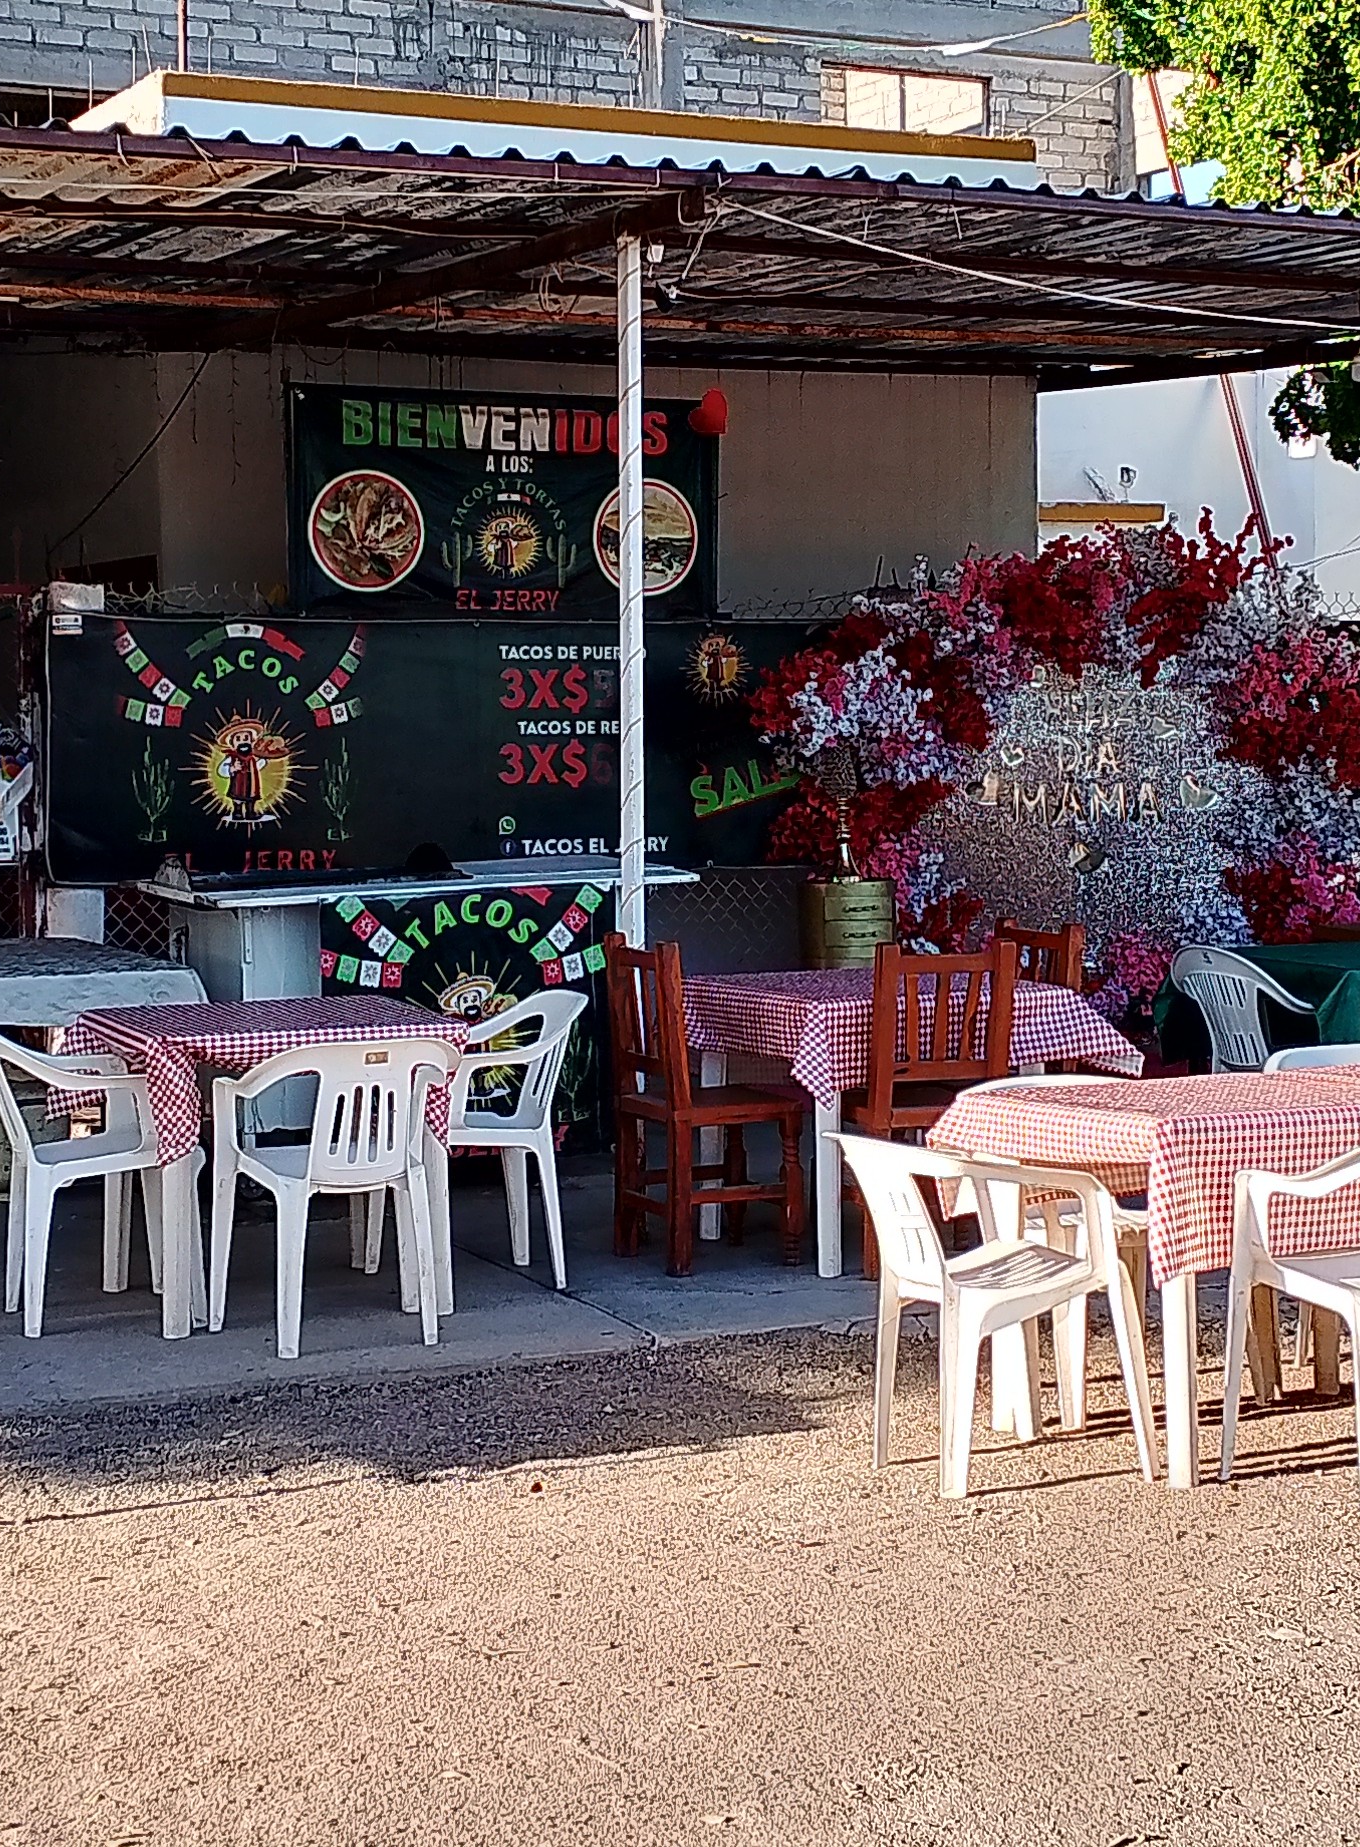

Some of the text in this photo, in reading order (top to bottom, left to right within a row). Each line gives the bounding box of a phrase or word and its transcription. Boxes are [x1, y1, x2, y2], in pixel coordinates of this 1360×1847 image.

[485, 455, 534, 474] A LOS:
[451, 477, 567, 531] TACOS Y TORTAS
[455, 589, 560, 612] EL JERRY
[499, 645, 553, 660] TACOS
[557, 645, 578, 660] DE
[191, 649, 299, 695] TACOS
[517, 720, 620, 735] TACOS DE RE
[521, 838, 583, 855] TACOS
[589, 837, 610, 853] EL
[242, 849, 337, 874] JERRY
[404, 893, 539, 950] TACOS
